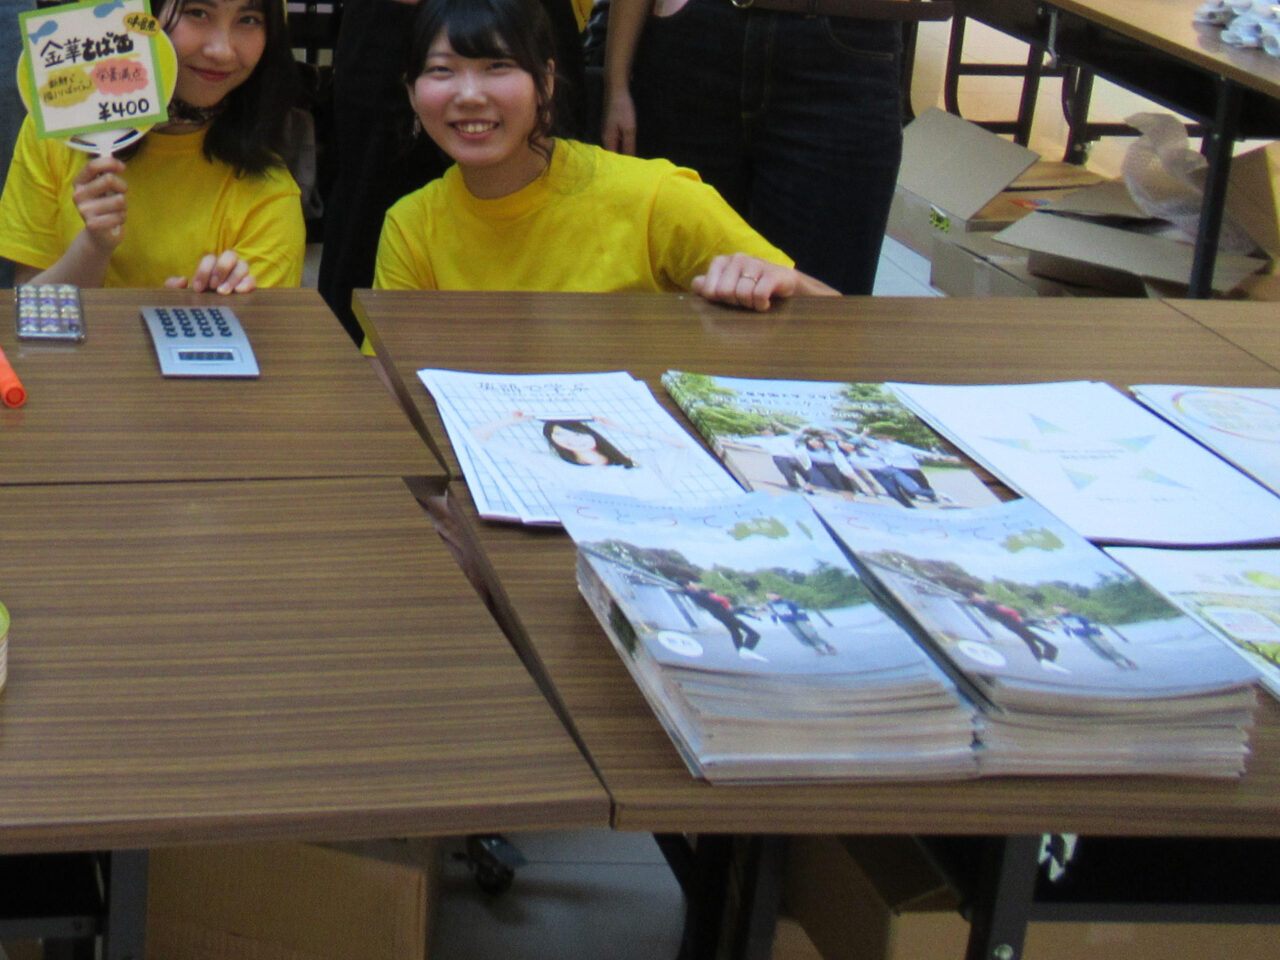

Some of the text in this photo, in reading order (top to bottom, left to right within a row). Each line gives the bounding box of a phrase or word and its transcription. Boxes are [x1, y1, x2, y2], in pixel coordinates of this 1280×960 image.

[40, 32, 135, 69] 金華さば缶
[98, 98, 150, 122] ¥400
